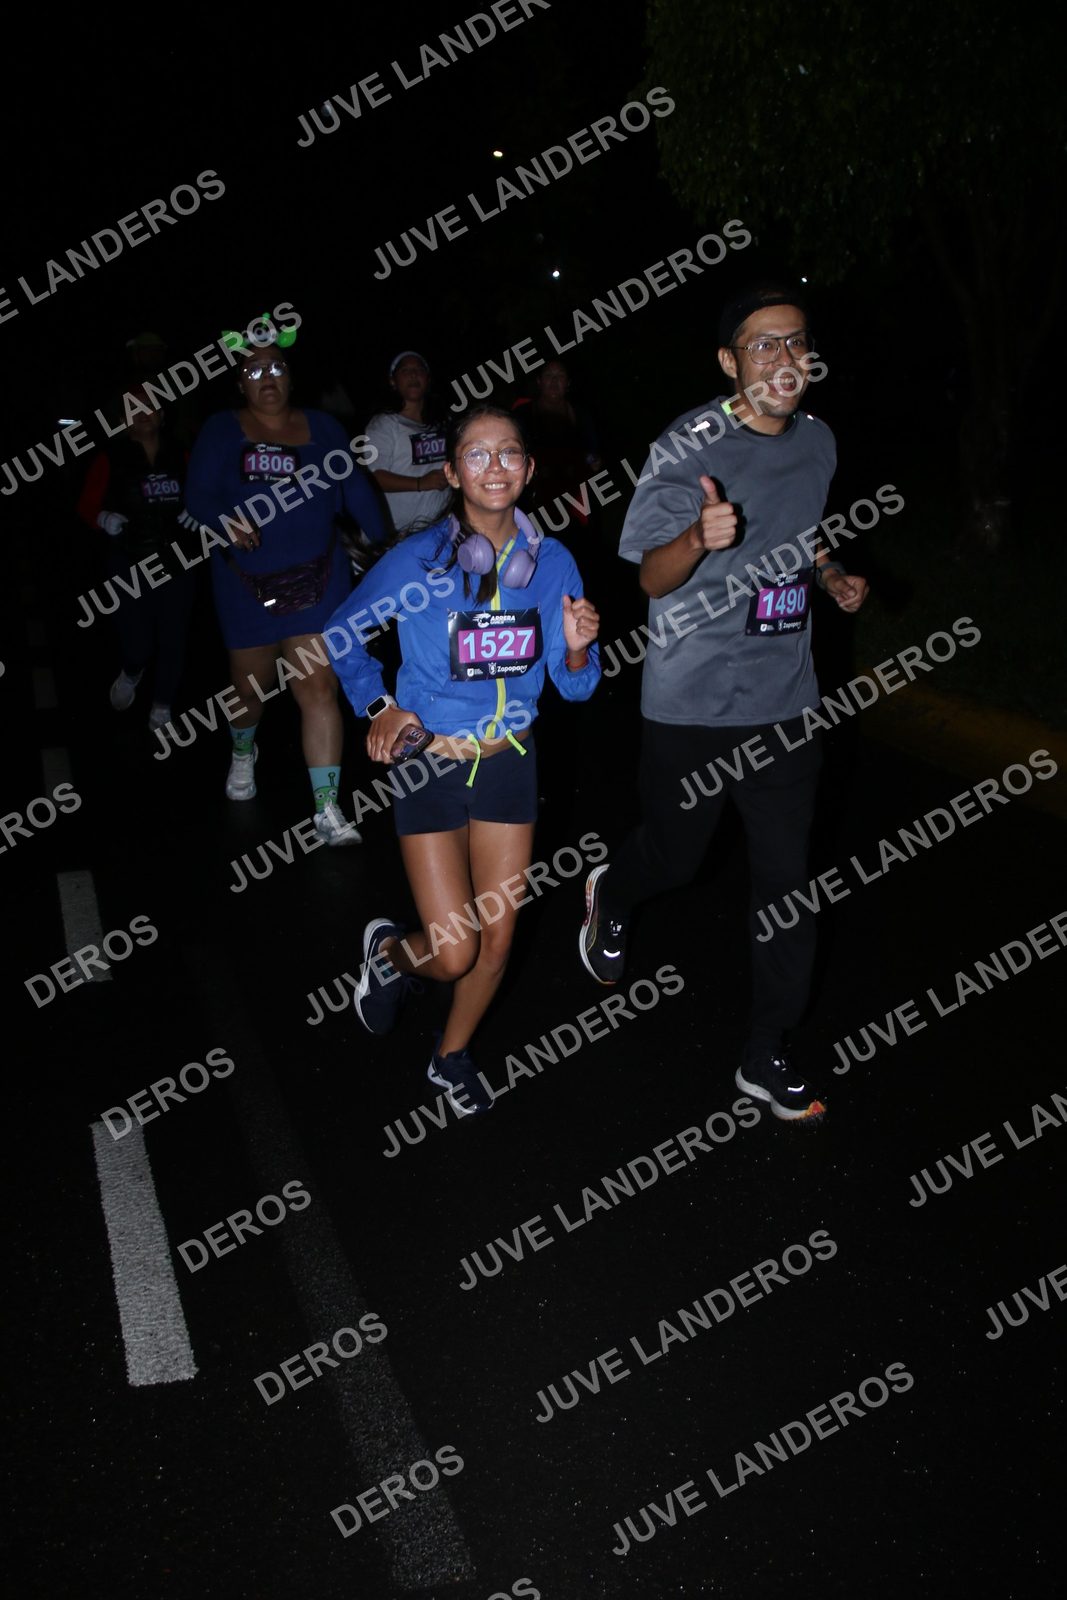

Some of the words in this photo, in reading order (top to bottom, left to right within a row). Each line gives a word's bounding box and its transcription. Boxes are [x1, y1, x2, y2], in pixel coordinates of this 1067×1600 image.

[416, 439, 446, 455] 1207
[247, 454, 295, 473] 1806
[143, 480, 180, 496] 1260
[762, 586, 806, 617] 1490
[463, 629, 534, 660] 1527
